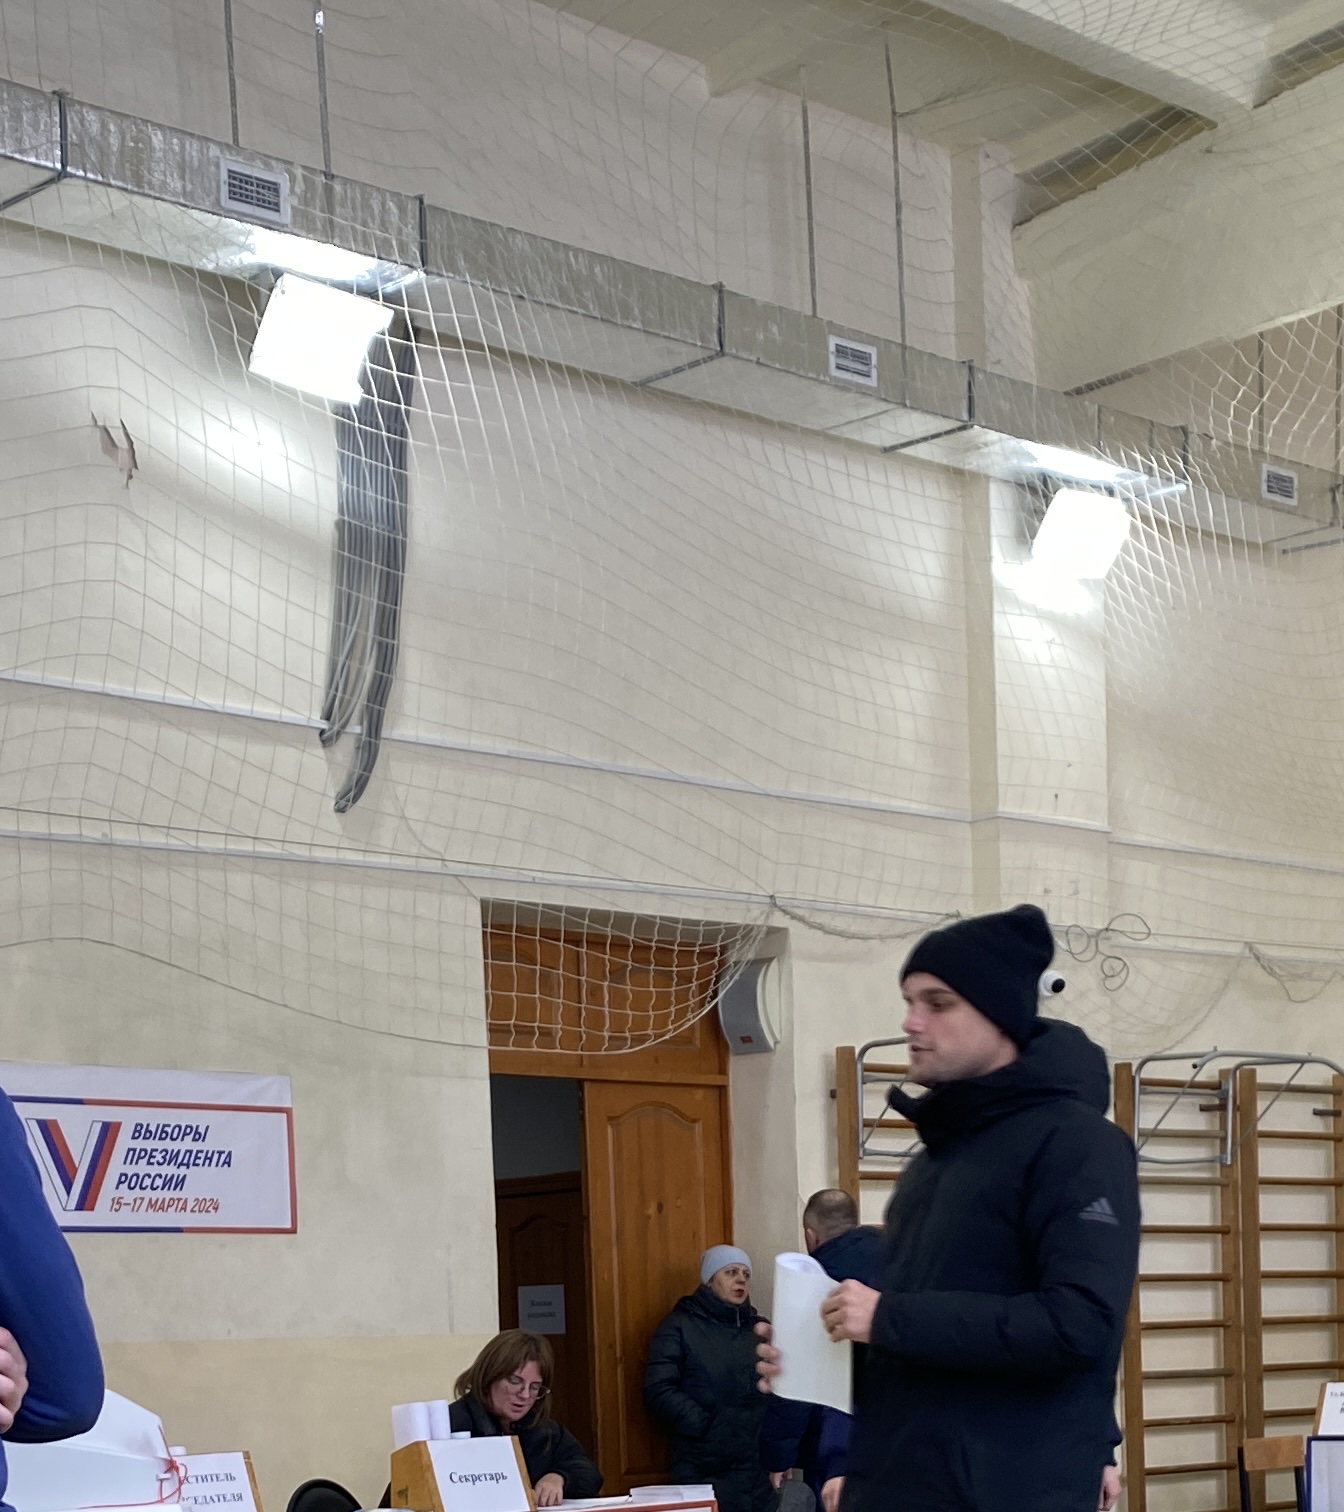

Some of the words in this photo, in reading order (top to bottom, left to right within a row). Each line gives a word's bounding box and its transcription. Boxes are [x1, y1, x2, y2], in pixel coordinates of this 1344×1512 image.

[130, 1122, 210, 1143] ВЫБОРЫ
[123, 1147, 233, 1169] ПРЕЗИДЕНТА
[115, 1172, 186, 1191] РОССИИ
[145, 1198, 187, 1213] МАРТА
[189, 1197, 220, 1213] 2024
[183, 1472, 236, 1484] СТИТЕЛЬ
[449, 1471, 508, 1485] Секретарь
[183, 1492, 243, 1505] ЕДАТЕЛЯ
